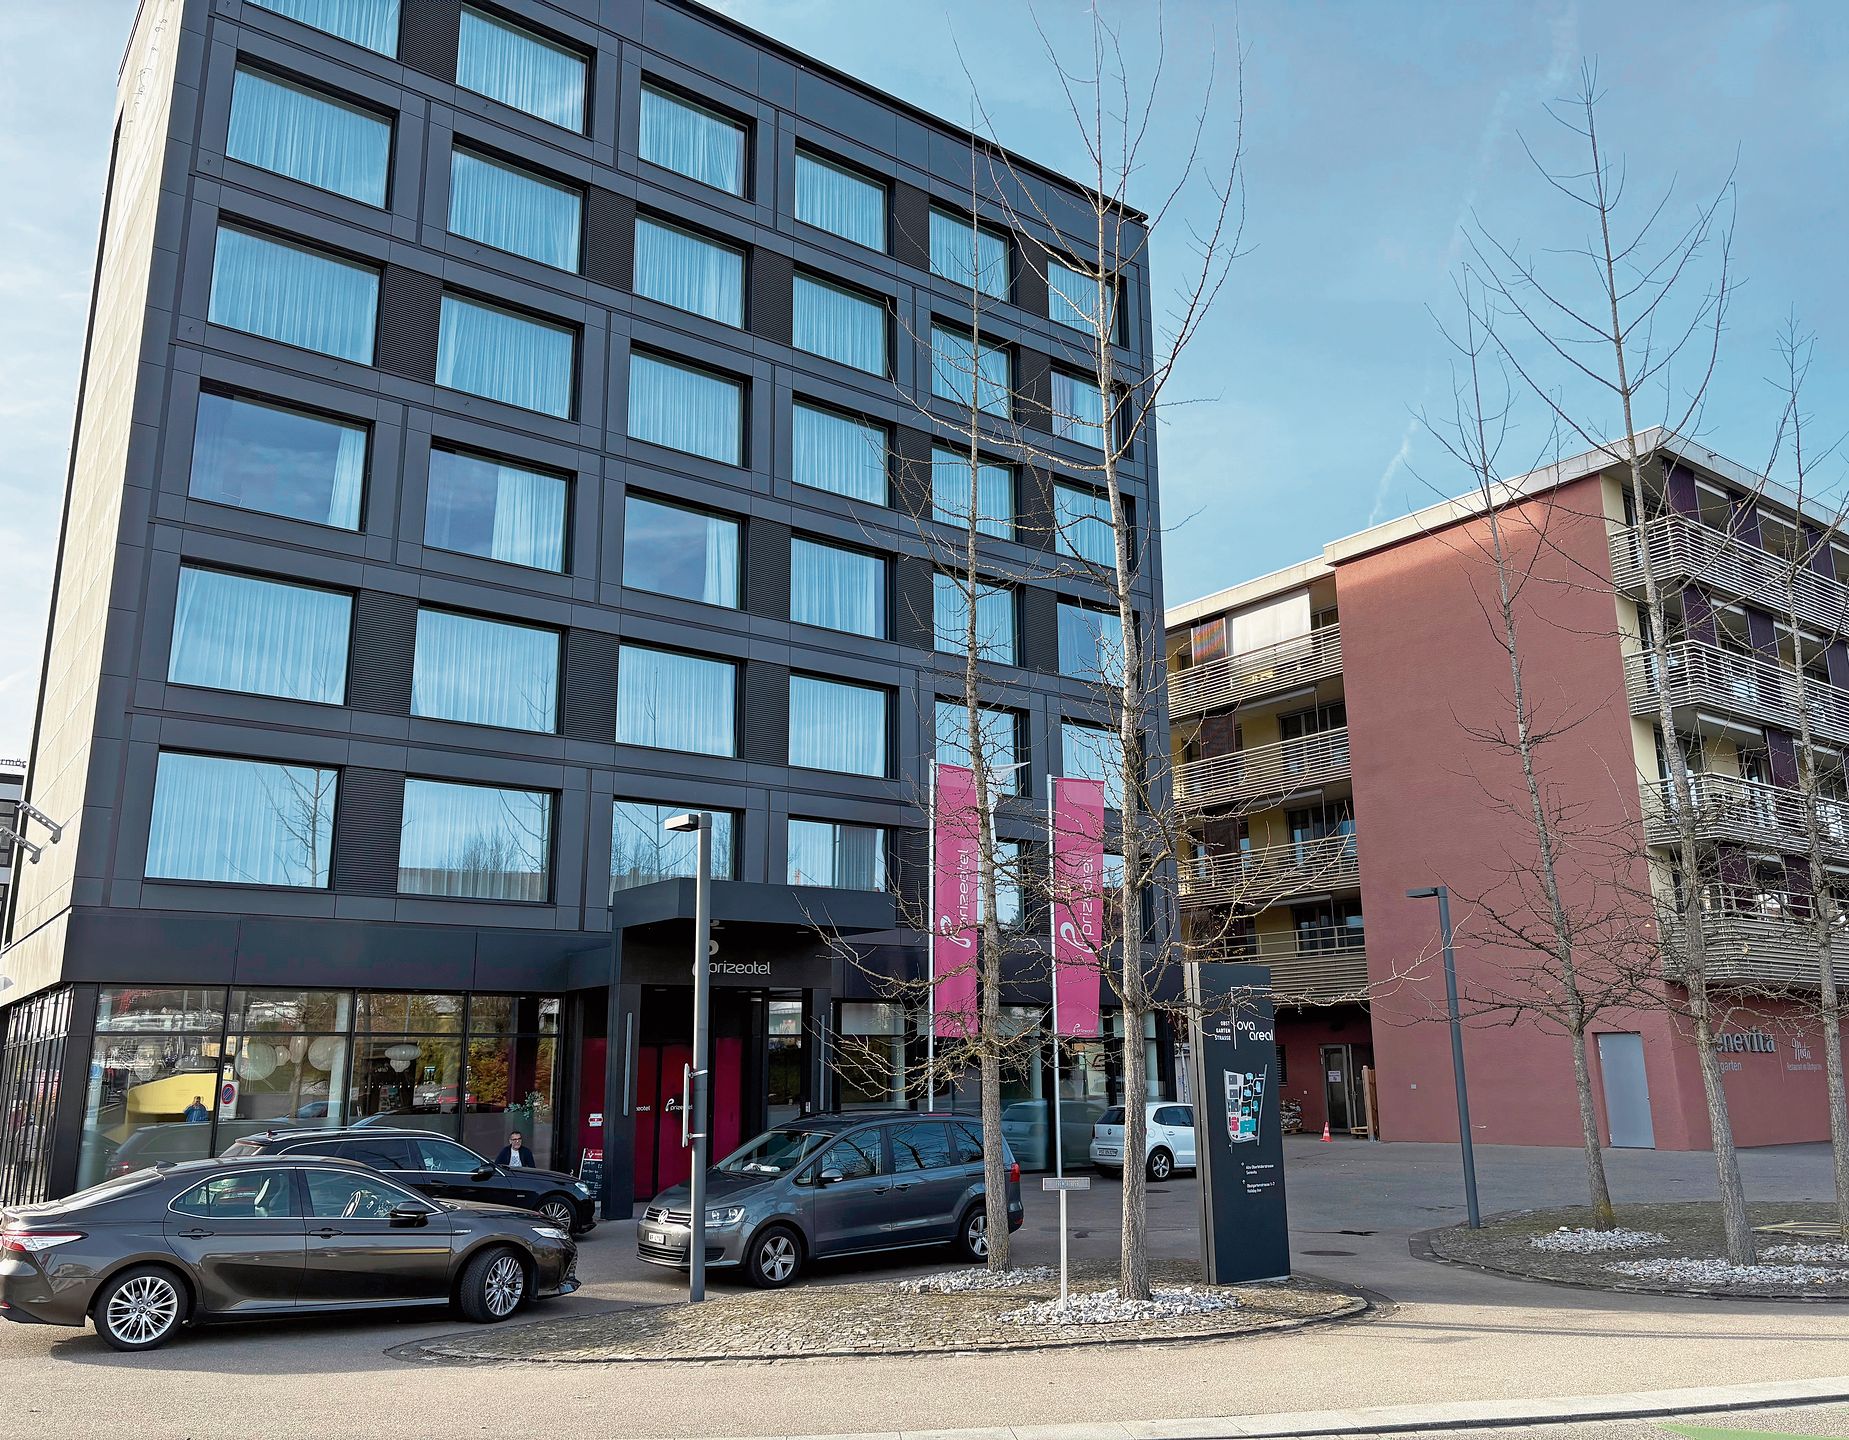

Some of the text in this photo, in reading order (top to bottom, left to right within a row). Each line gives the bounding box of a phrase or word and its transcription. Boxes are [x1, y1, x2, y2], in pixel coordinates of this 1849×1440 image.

[1080, 858, 1094, 936] prizotel
[1236, 1021, 1256, 1031] ova
[1249, 1029, 1274, 1041] areal
[1713, 1030, 1776, 1052] enevita
